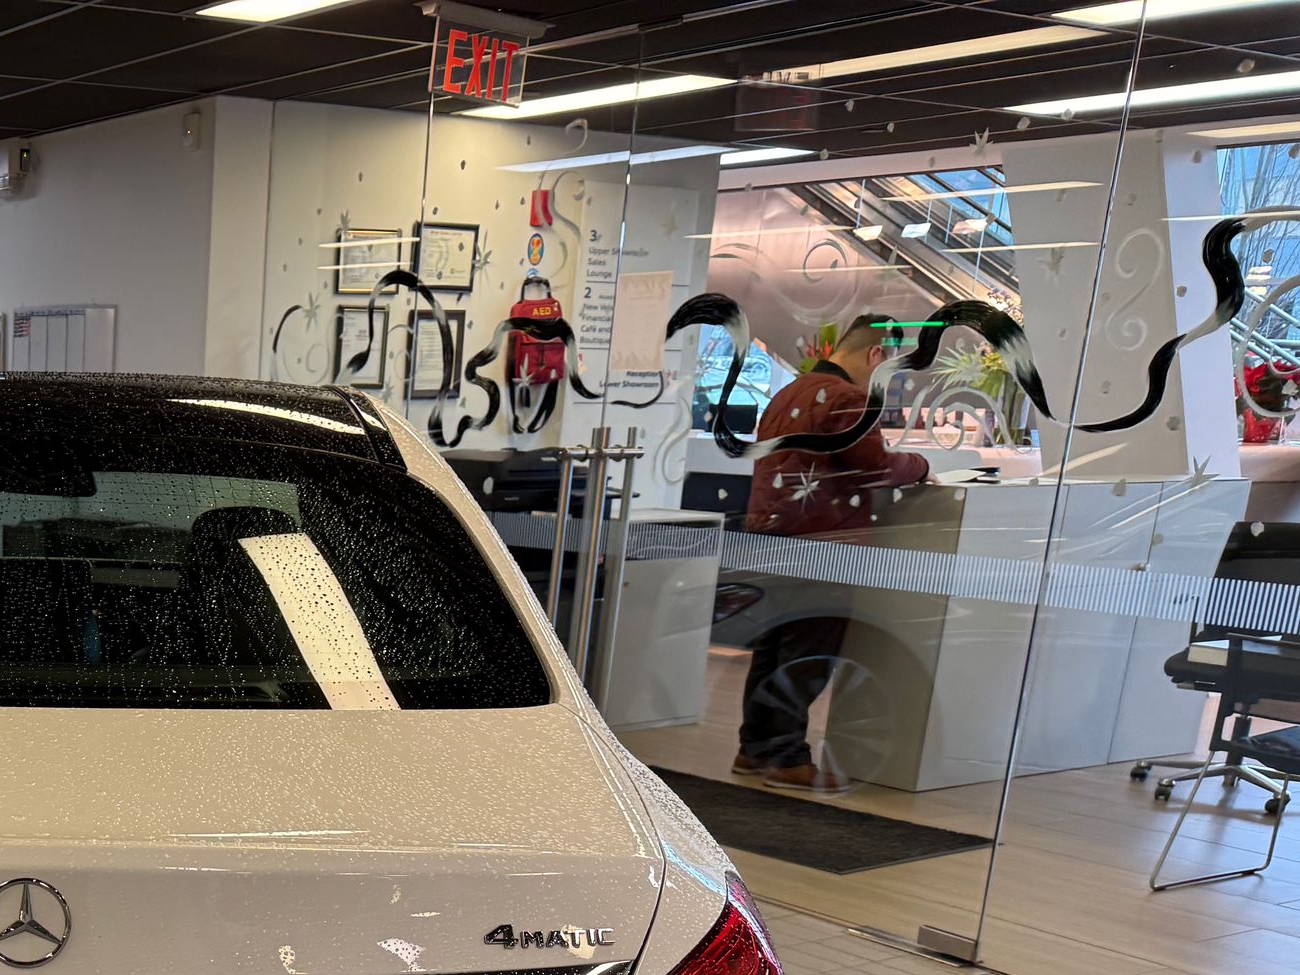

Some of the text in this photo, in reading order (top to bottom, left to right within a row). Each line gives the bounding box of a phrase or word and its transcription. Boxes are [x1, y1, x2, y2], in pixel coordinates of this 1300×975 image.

[442, 29, 520, 104] EXIT
[589, 229, 598, 242] 3
[588, 246, 610, 255] Upper
[587, 257, 606, 266] Sales
[586, 269, 612, 279] Lounge
[584, 286, 592, 299] 2
[532, 306, 552, 316] AED
[483, 924, 617, 949] 4MATIC
